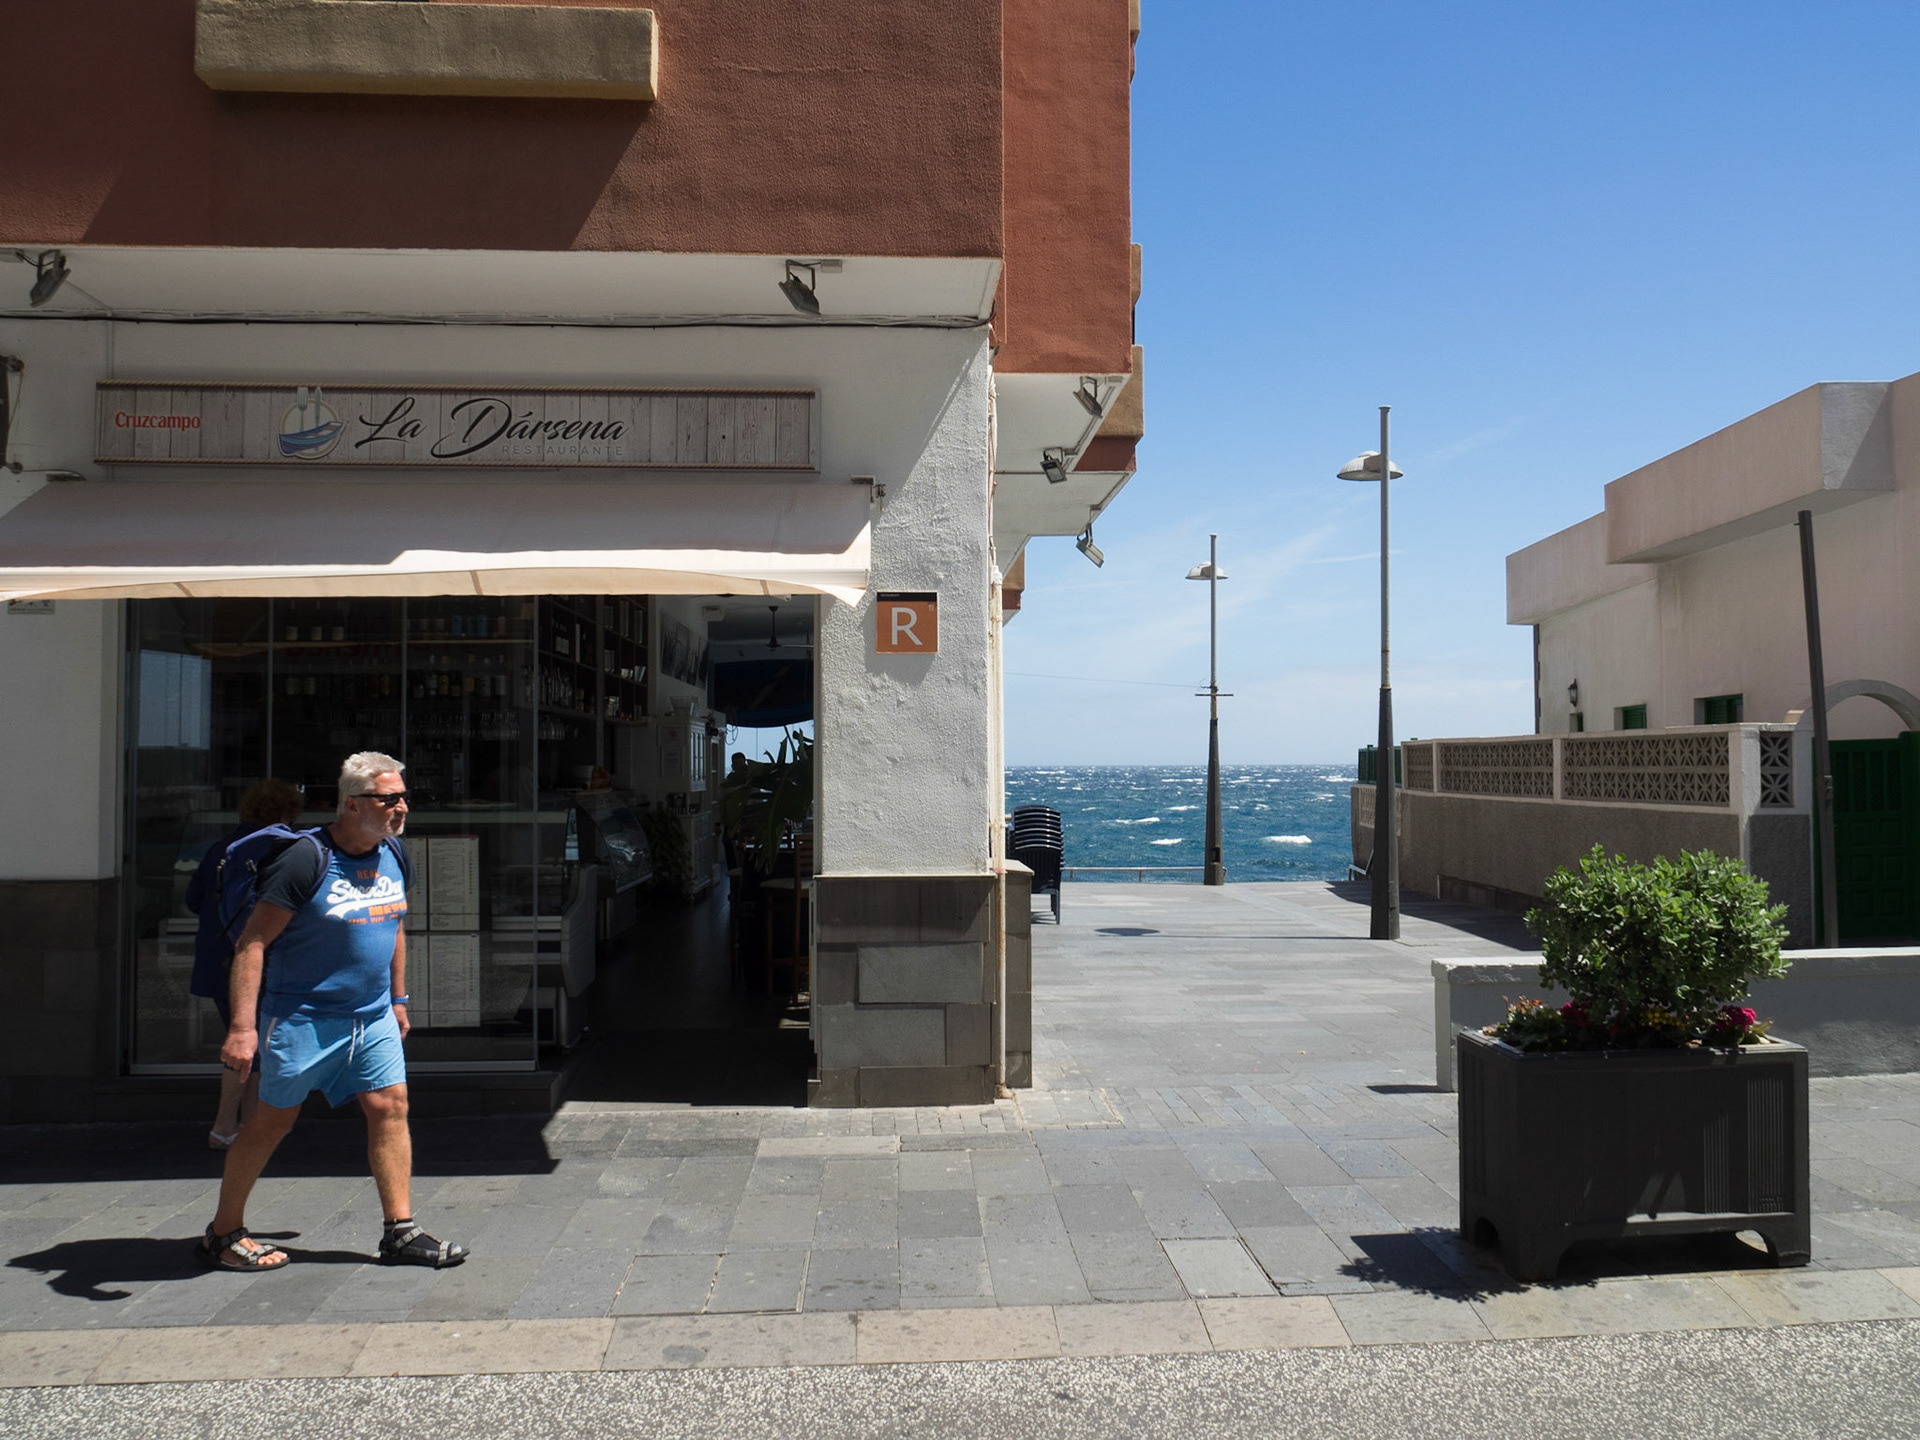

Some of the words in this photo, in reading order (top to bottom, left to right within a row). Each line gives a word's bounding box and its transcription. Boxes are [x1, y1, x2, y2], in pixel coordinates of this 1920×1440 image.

[115, 411, 201, 431] Cruzcampo
[354, 396, 427, 449] La
[431, 397, 629, 459] Dársena
[502, 445, 624, 456] RESTAURANTE
[891, 606, 923, 646] R
